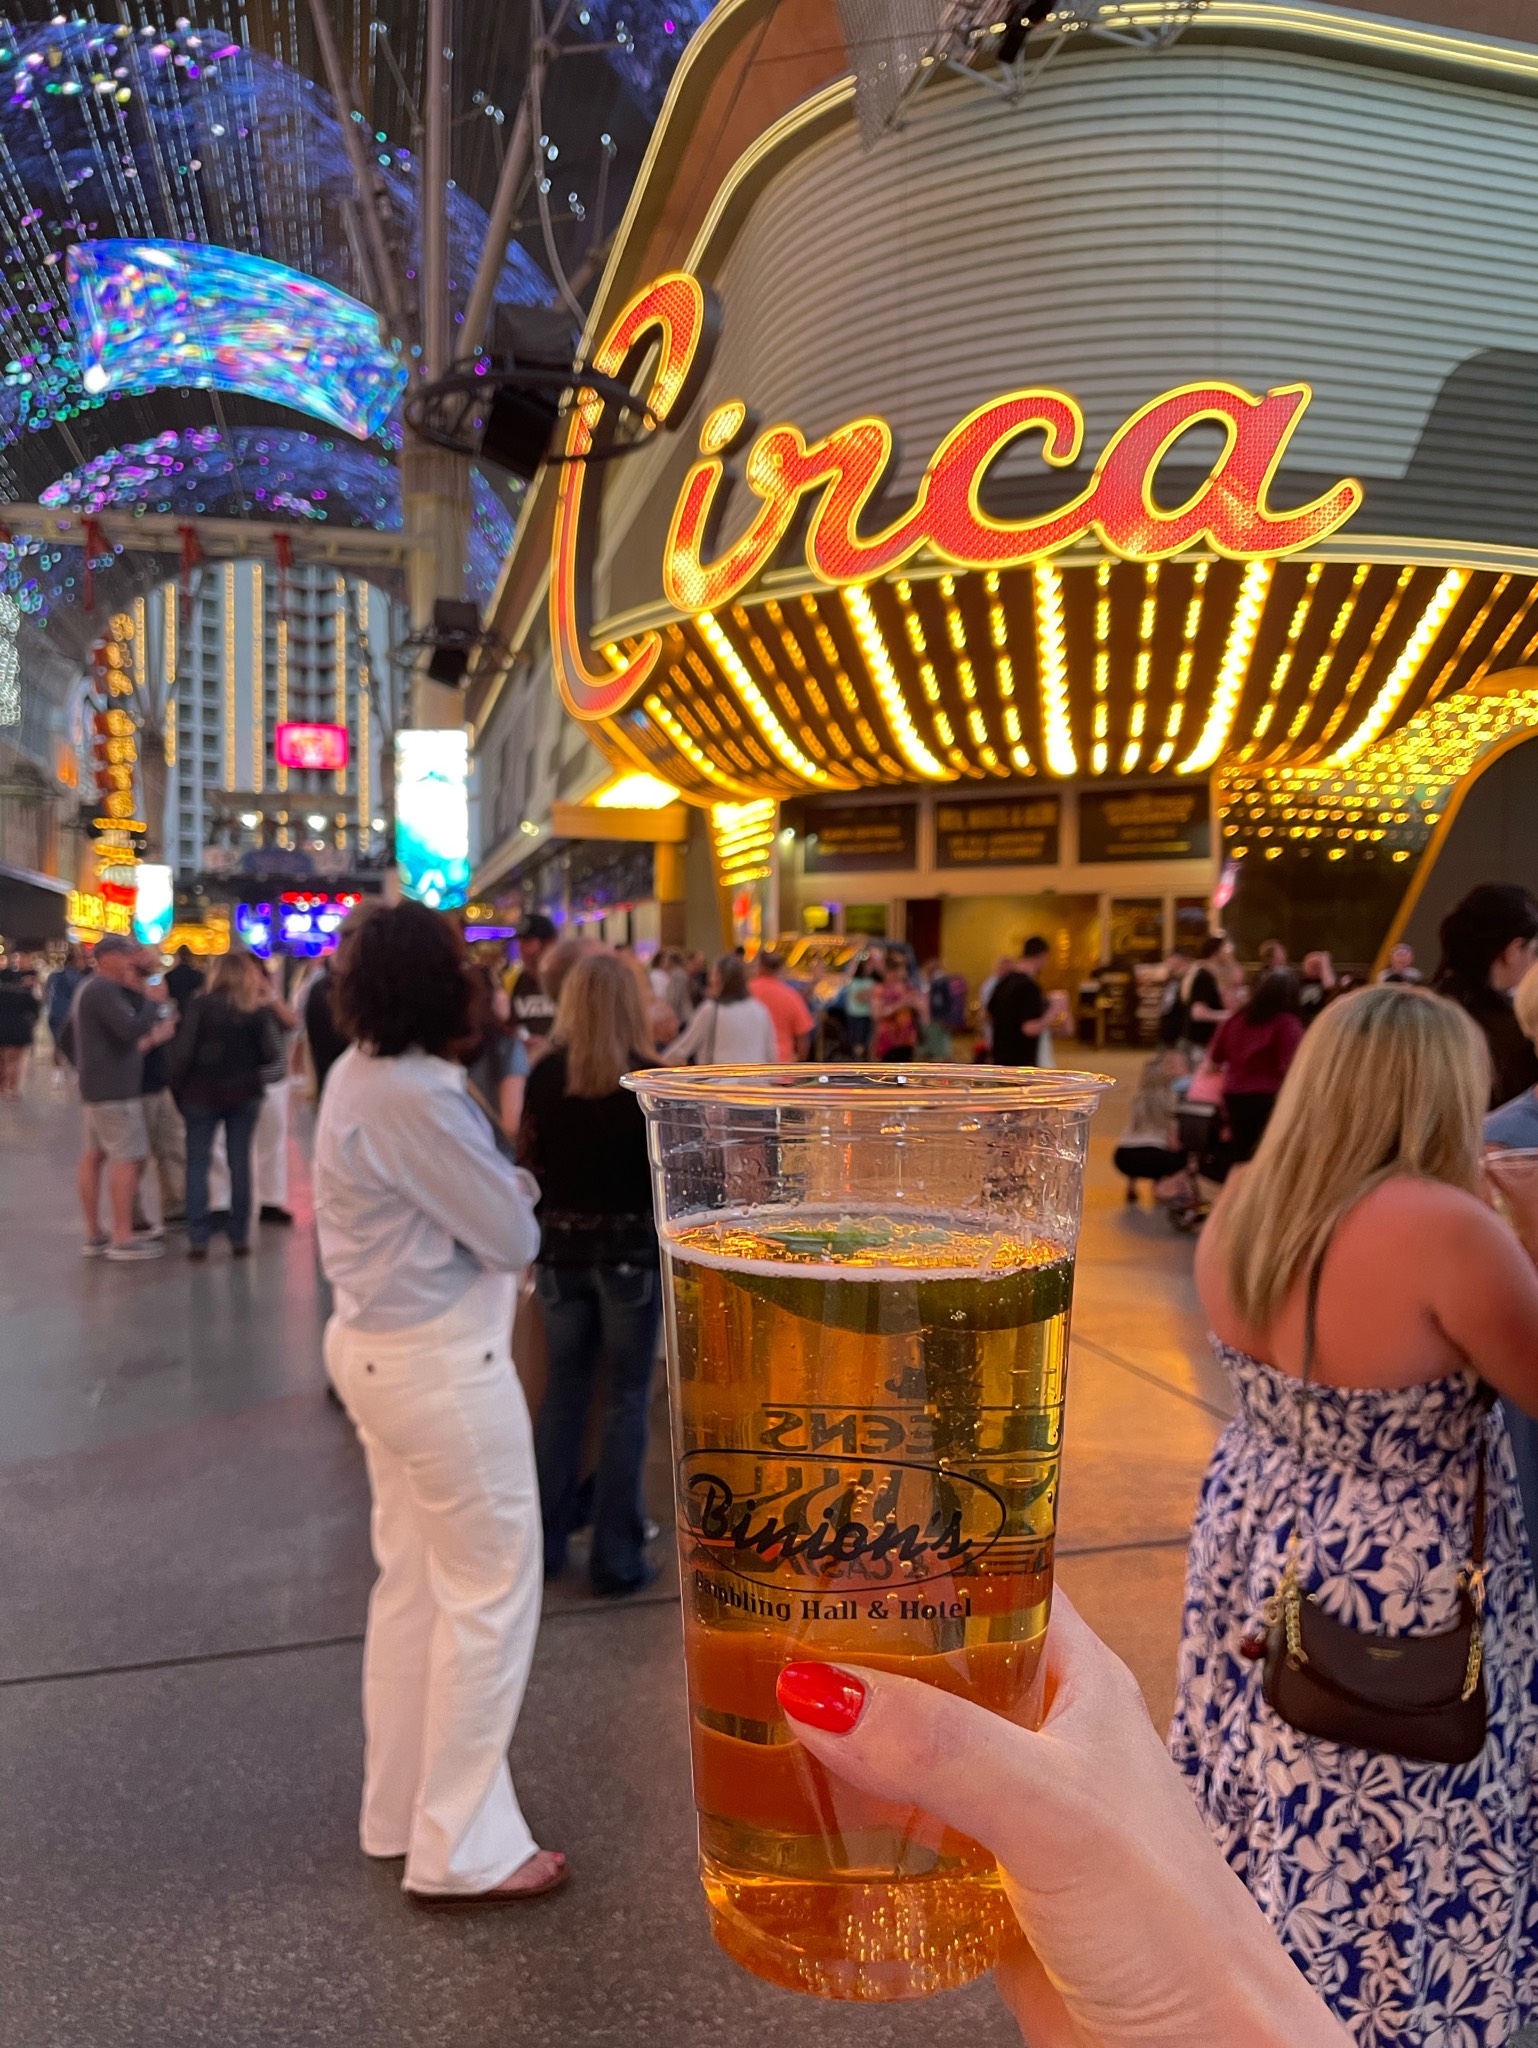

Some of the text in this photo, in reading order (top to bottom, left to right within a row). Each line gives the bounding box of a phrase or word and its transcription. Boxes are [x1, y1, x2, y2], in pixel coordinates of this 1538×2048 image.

[550, 271, 1363, 722] Circa
[688, 1473, 972, 1561] Binion's
[694, 1568, 972, 1622] Gambling Hall & Hotel
